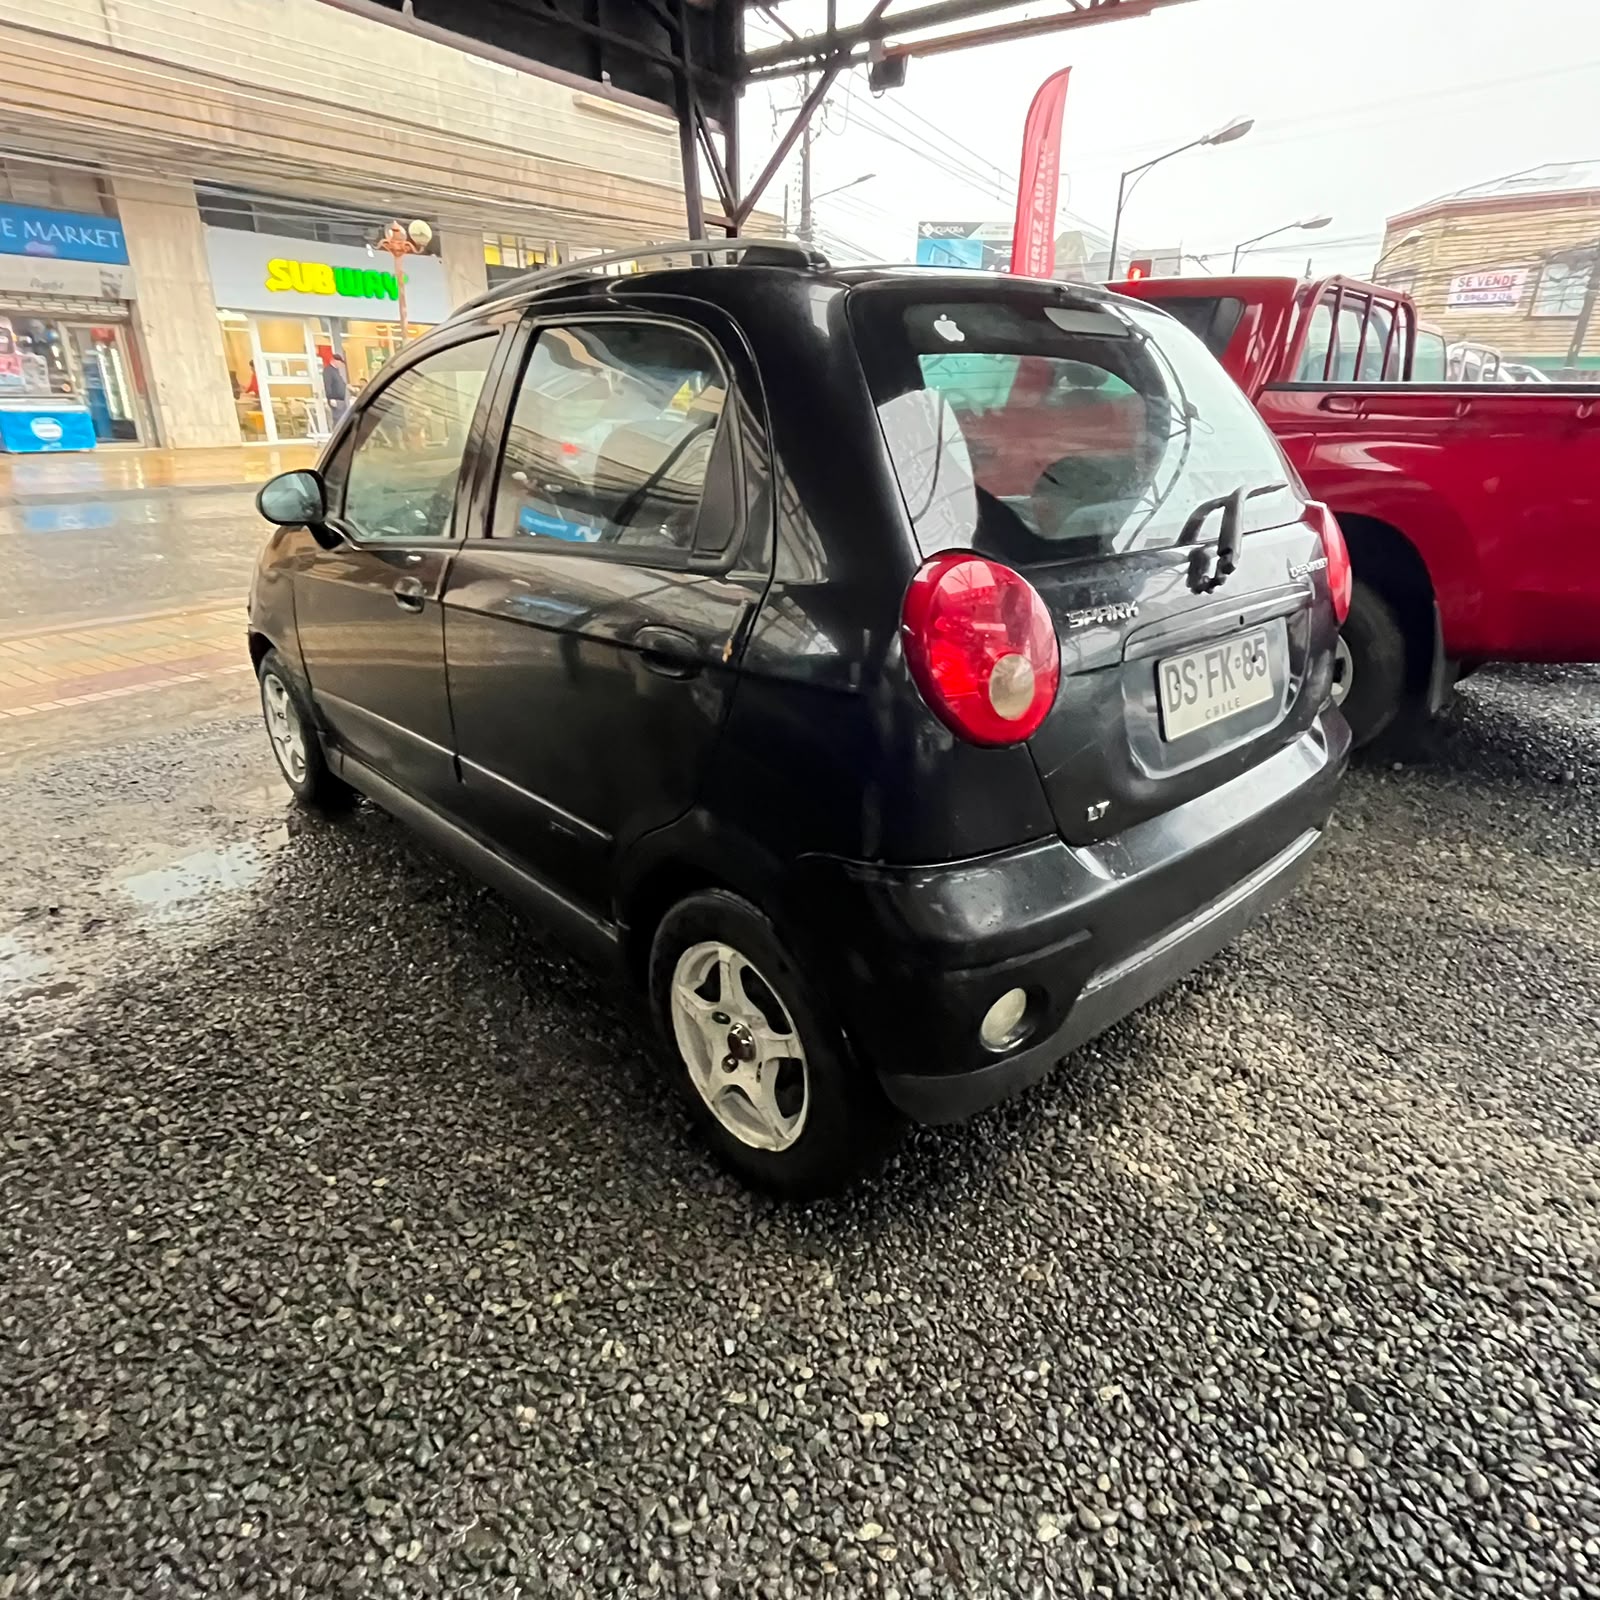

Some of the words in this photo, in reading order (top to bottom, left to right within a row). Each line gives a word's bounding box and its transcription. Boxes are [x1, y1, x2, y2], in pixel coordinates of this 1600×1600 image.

[23, 220, 120, 249] MARKET
[1029, 220, 1043, 277] EREZ
[265, 258, 408, 301] SUBWAY
[1457, 276, 1474, 288] SE
[1477, 274, 1519, 288] VENDE
[1066, 600, 1139, 629] SPARK
[1205, 697, 1241, 720] CHILE
[1087, 800, 1110, 822] LT
